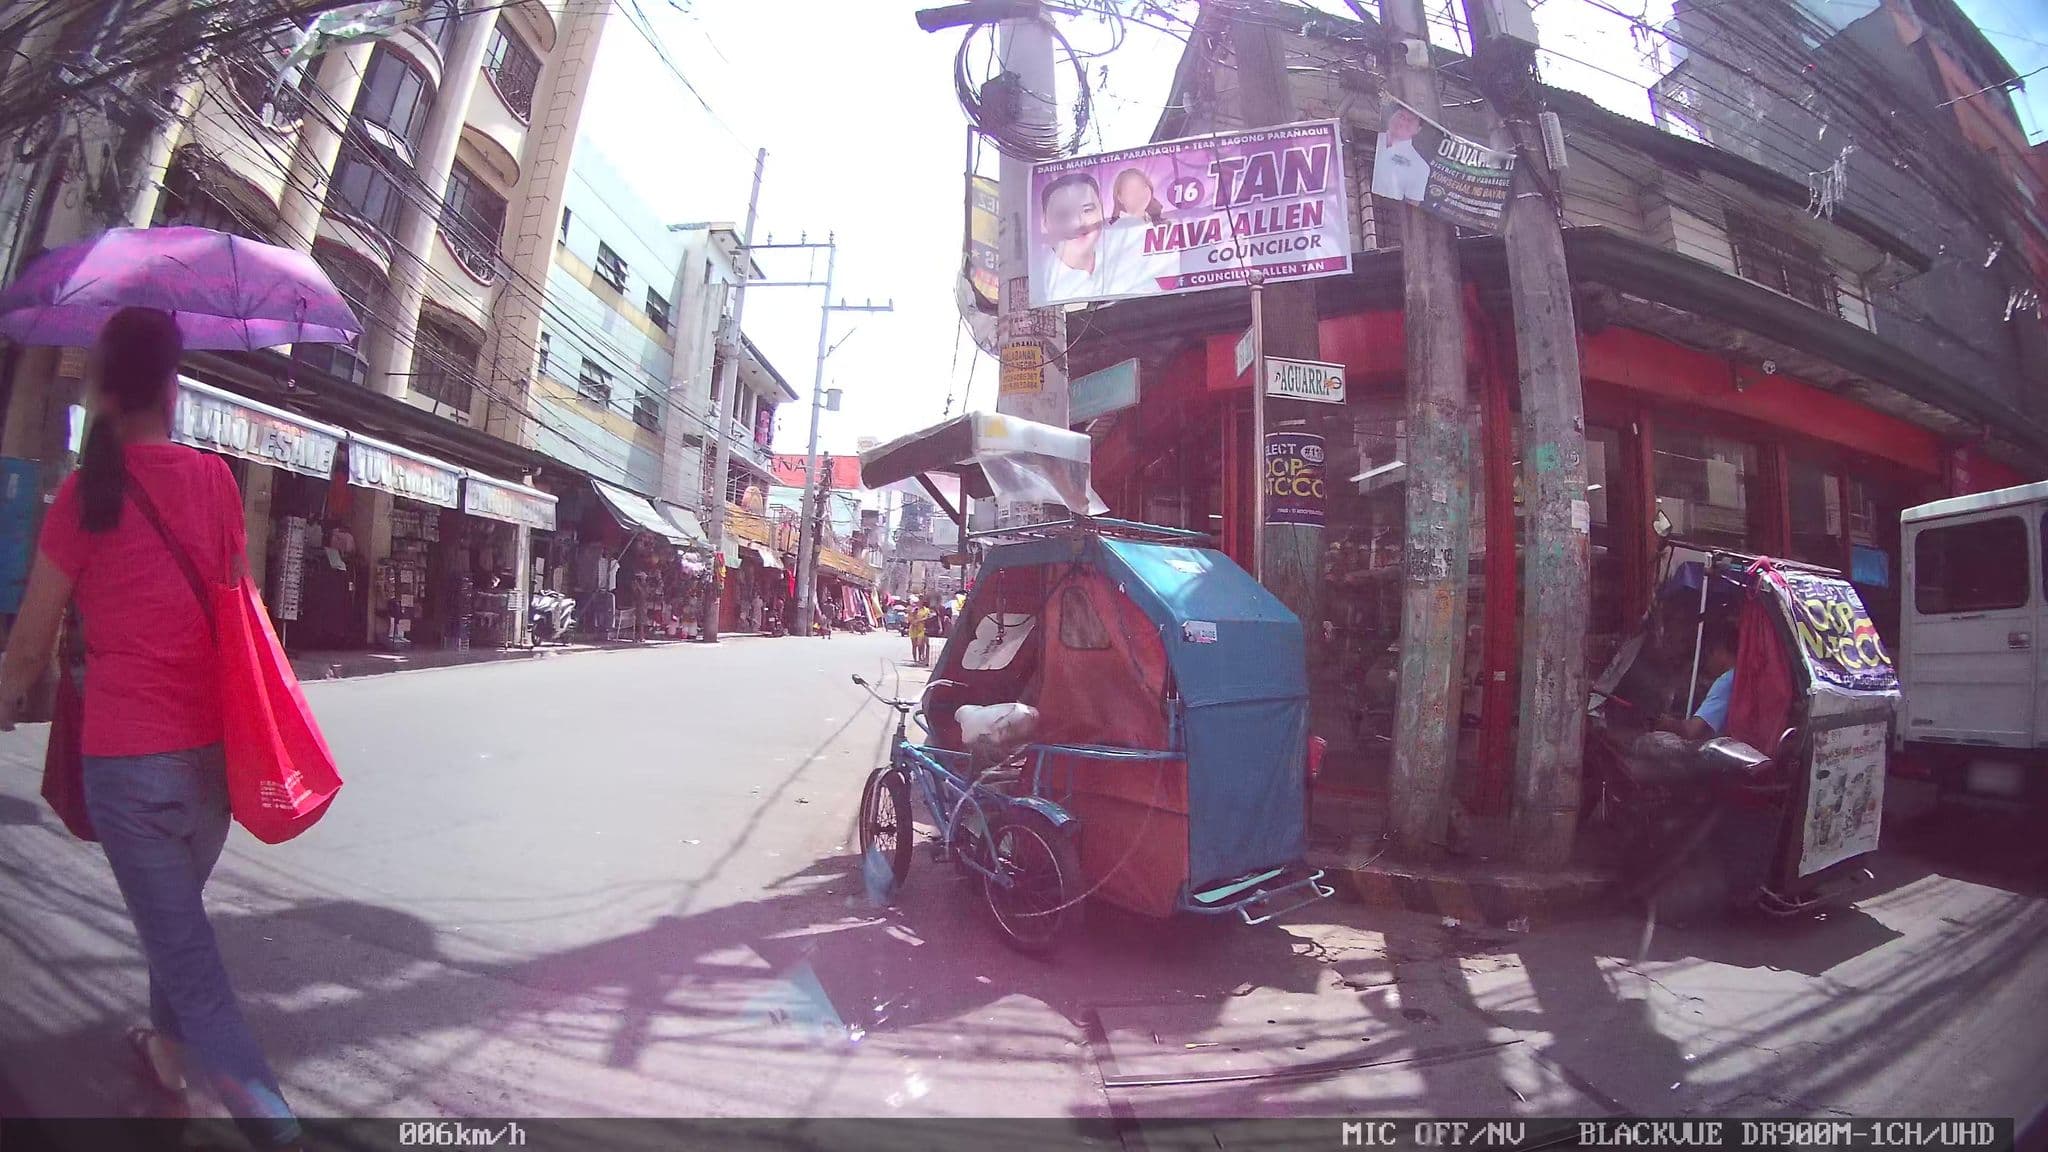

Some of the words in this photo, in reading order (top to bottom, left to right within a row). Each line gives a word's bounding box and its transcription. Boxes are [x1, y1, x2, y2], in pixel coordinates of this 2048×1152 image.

[1037, 164, 1064, 175] DAHIL
[1066, 158, 1099, 170] MAHAL
[1100, 154, 1121, 164] KITA
[1221, 133, 1265, 147] BAGONG
[1267, 126, 1330, 141] PARAÑAQUE
[1173, 181, 1200, 204] 16
[1209, 143, 1331, 209] TAN
[1143, 218, 1222, 255] NAVA
[1233, 199, 1325, 240] ALLEN
[1207, 234, 1322, 264] COUNCILOR
[1190, 268, 1250, 284] COUNCILO
[1262, 264, 1298, 277] ALLEN
[1300, 260, 1326, 273] TAN
